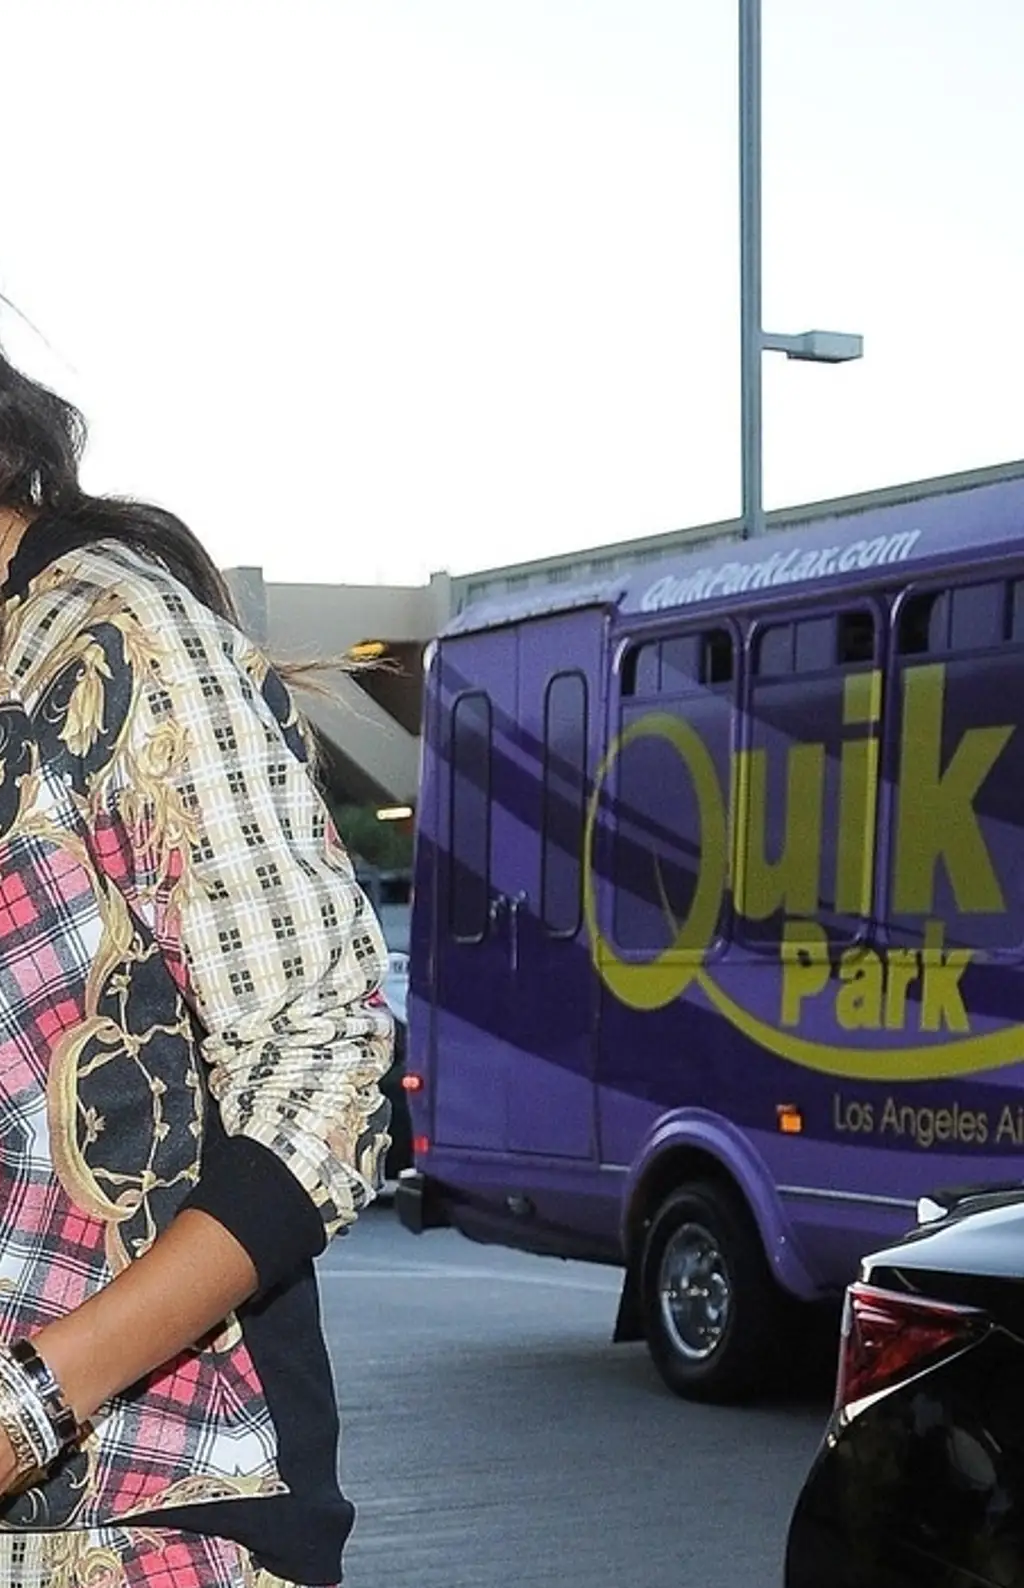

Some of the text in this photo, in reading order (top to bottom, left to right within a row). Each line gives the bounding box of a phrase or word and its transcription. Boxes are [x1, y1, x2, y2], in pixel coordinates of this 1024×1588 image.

[584, 663, 1016, 1011] Quik
[780, 919, 972, 1033] Park
[832, 1092, 874, 1133] Los
[879, 1097, 989, 1147] Angeles
